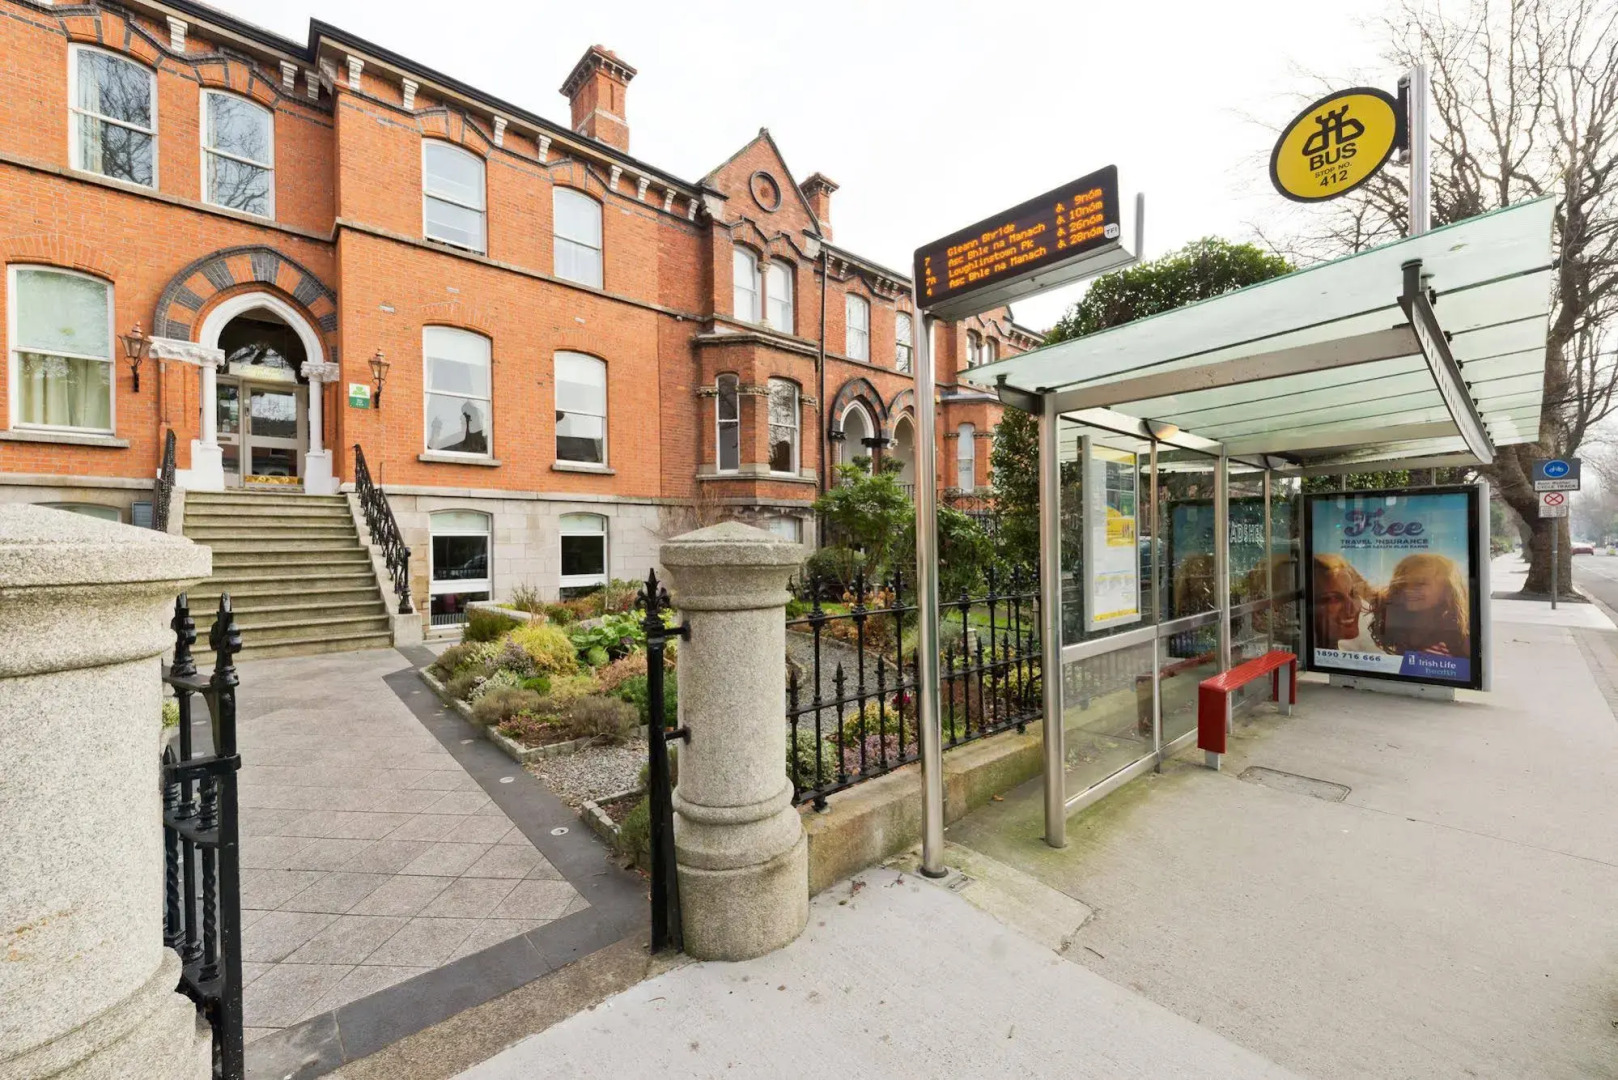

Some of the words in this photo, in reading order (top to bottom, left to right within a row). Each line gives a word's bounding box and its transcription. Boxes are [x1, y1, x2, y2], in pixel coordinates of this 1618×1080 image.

[1309, 142, 1357, 171] BUS
[1315, 166, 1336, 179] STOP
[1320, 170, 1348, 187] 412
[925, 257, 931, 266] 7
[947, 239, 979, 257] Gleann
[967, 245, 989, 260] Bhle
[993, 240, 1006, 250] na
[1009, 223, 1046, 243] Manach
[948, 246, 1017, 278] Loughlinstown
[968, 267, 990, 282] Bhle
[994, 262, 1007, 272] na
[1010, 246, 1047, 266] Manach
[1343, 507, 1425, 537] Free
[1316, 650, 1339, 658] 1890
[1342, 652, 1360, 660] 716
[1362, 654, 1382, 662] 666
[1419, 659, 1439, 668] Irish
[1439, 660, 1457, 669] Life
